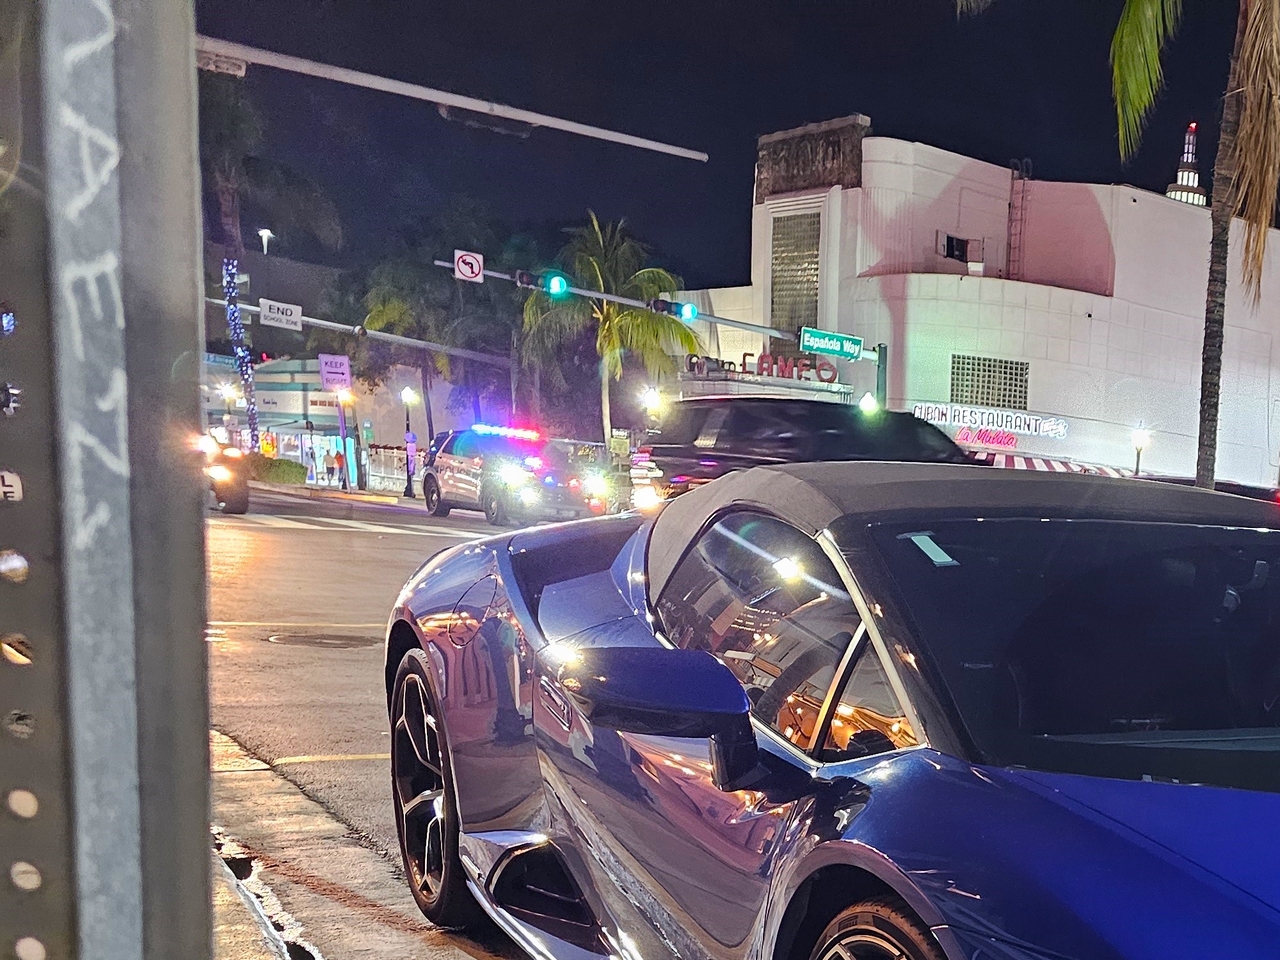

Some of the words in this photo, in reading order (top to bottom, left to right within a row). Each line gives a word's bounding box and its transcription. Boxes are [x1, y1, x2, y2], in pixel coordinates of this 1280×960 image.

[268, 304, 293, 317] END
[803, 332, 841, 352] Española
[842, 339, 860, 357] Way
[324, 361, 344, 369] KEEP
[742, 352, 838, 383] CAMEO
[952, 408, 1041, 434] RESTAURANT
[956, 427, 971, 442] La
[971, 428, 1018, 448] Mulata
